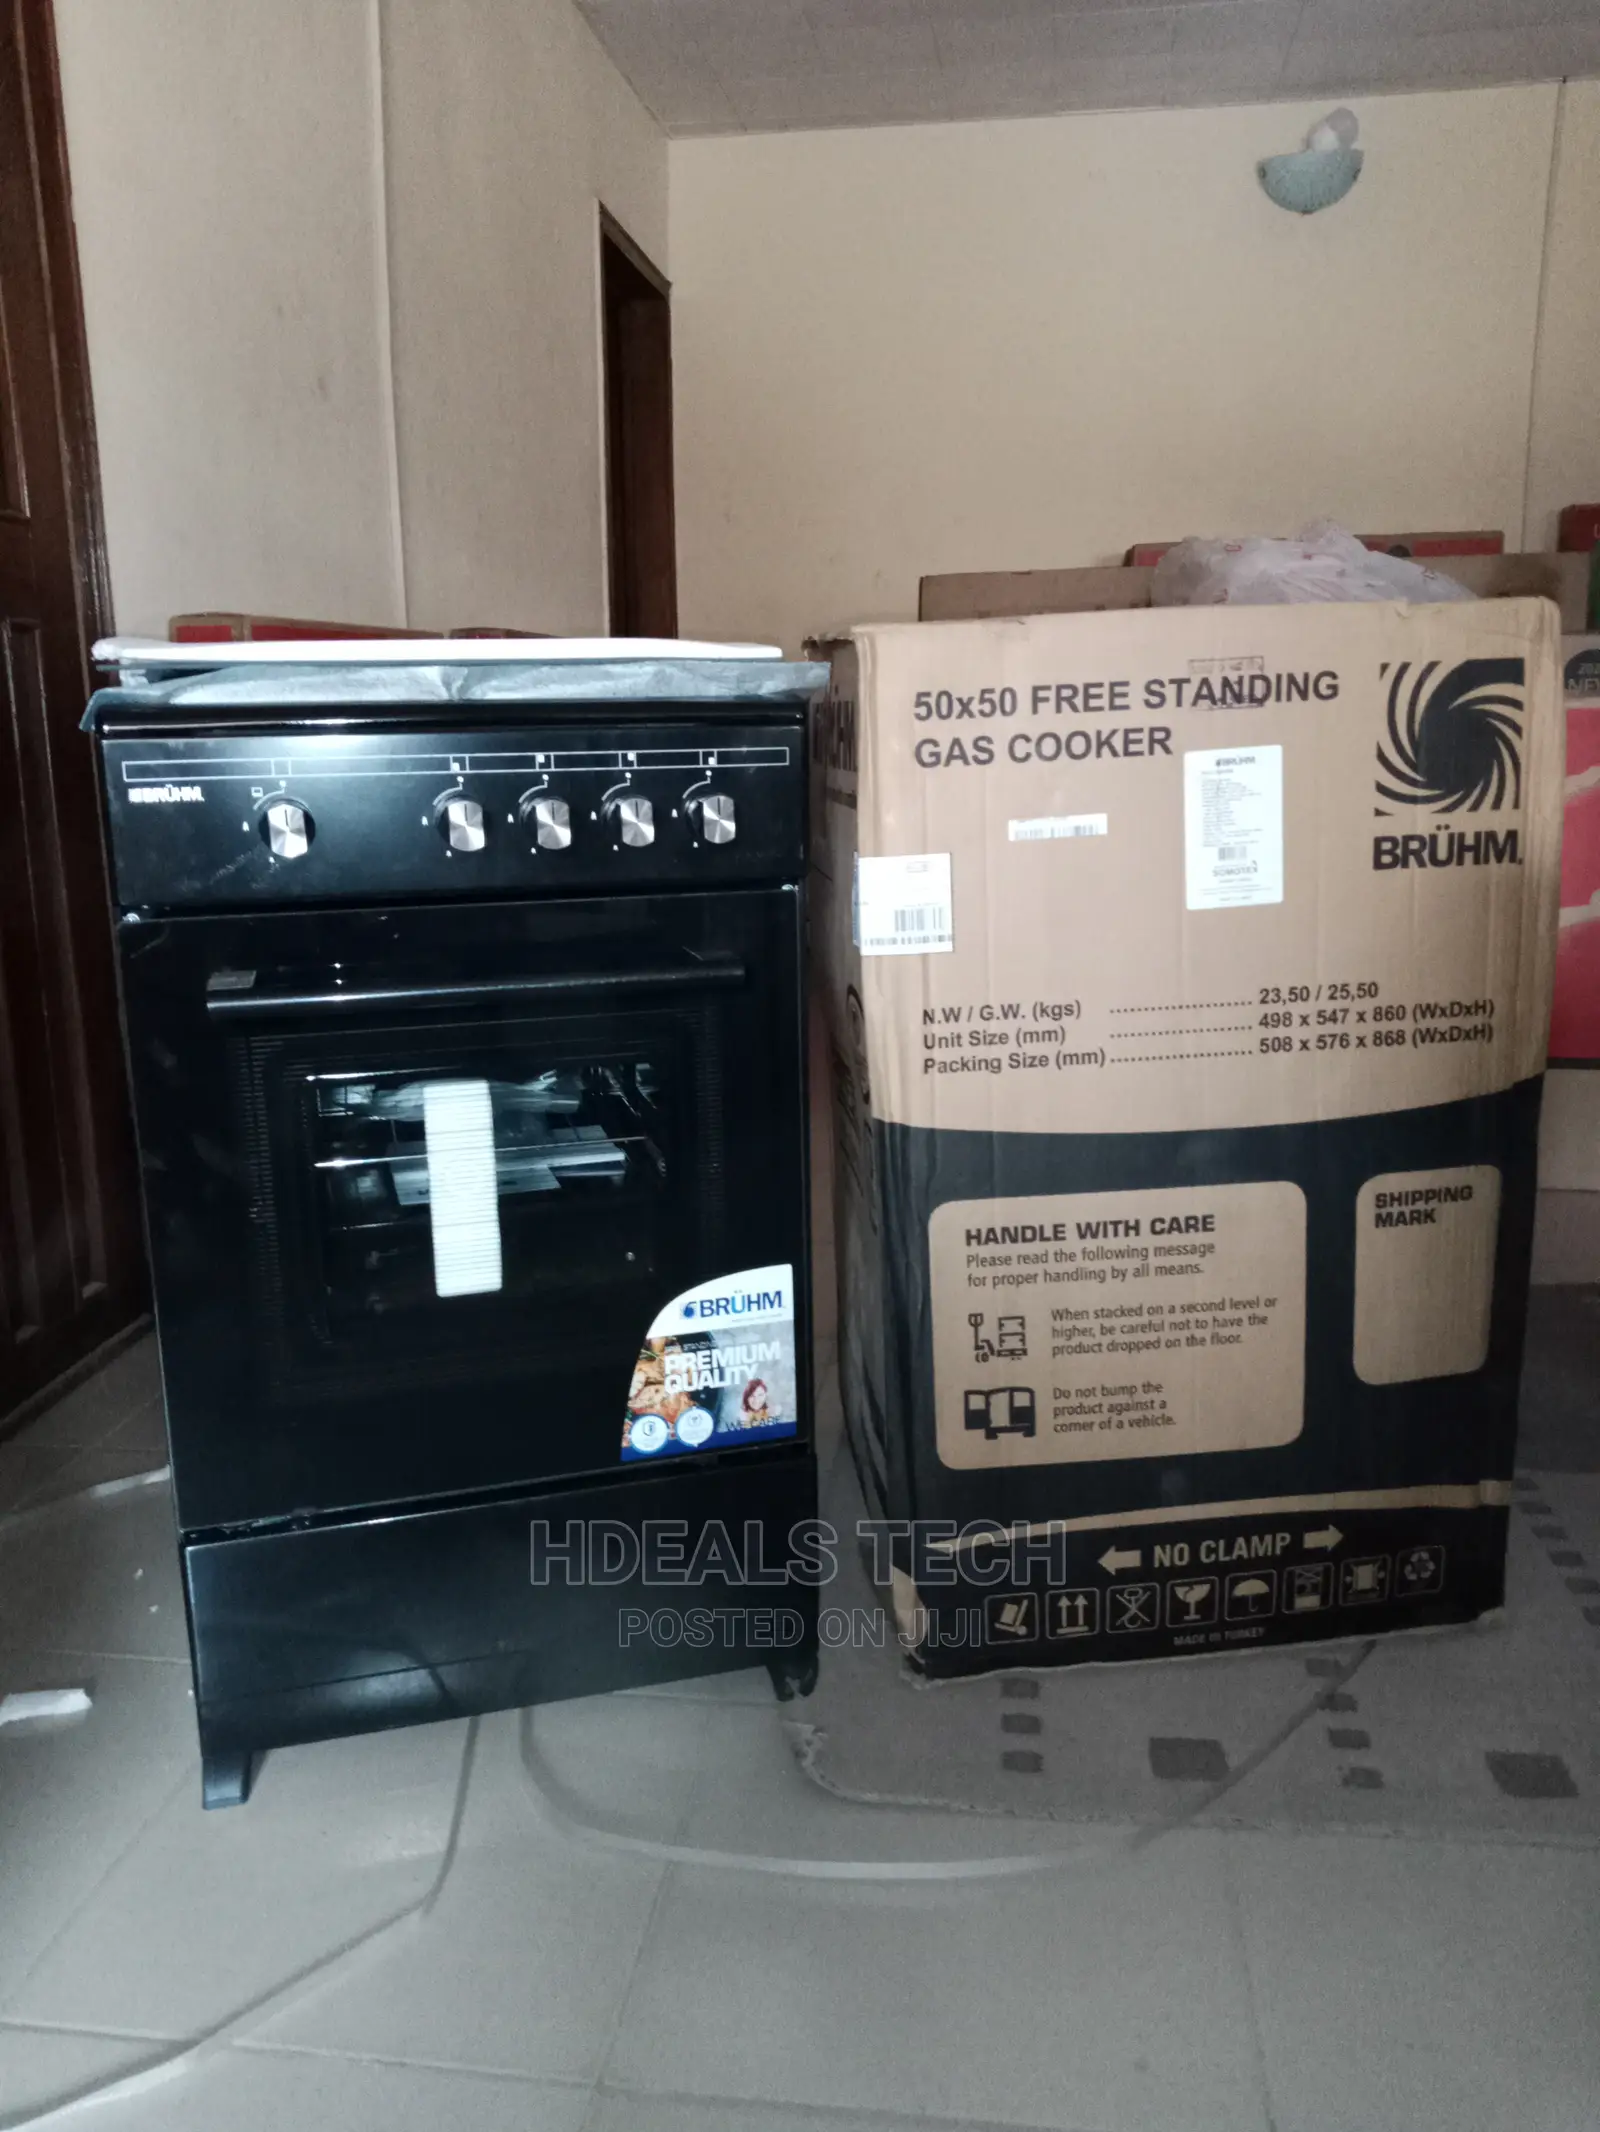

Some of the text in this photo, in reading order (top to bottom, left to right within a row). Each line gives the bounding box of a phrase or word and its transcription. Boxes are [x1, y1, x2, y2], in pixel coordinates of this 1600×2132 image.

[913, 687, 1019, 721] 50x50
[1031, 682, 1131, 715] FREE
[1143, 670, 1339, 711] STANDING
[914, 727, 1173, 769] GAS COOKER
[923, 1006, 961, 1025] N.W
[980, 1004, 1026, 1021] G.W.
[1032, 1000, 1081, 1022] (kgs)
[1259, 986, 1310, 1006] 23,50
[1328, 981, 1379, 1002] 25,50
[924, 999, 1495, 1050] Unit Size (mm) 498 x 547 x 860 (WxDxH)
[923, 1023, 1494, 1074] Packing Size (mm) 508 x 576 x 868 (WxDxH)
[1375, 1184, 1474, 1209] SHIPPING
[965, 1214, 1215, 1246] HANDLE WITH CARE
[1374, 1208, 1436, 1229] MARK
[966, 1242, 1215, 1268] Please read the following message
[967, 1262, 1203, 1289] for proper handling by all means.
[700, 1290, 782, 1318] BRÜHM
[1051, 1295, 1277, 1322] When stacked on a second level or
[1052, 1312, 1268, 1340] higher, be careful not to have the
[664, 1341, 780, 1374] PREMIUM
[1052, 1330, 1243, 1358] product dropped on the floor.
[664, 1363, 758, 1395] QUALITY
[1053, 1381, 1163, 1400] Do not bump the
[1053, 1399, 1166, 1418] product against a
[1054, 1412, 1176, 1433] corner of a vehicle.
[1153, 1533, 1291, 1568] NO CLAMP
[1173, 1633, 1206, 1646] MADE
